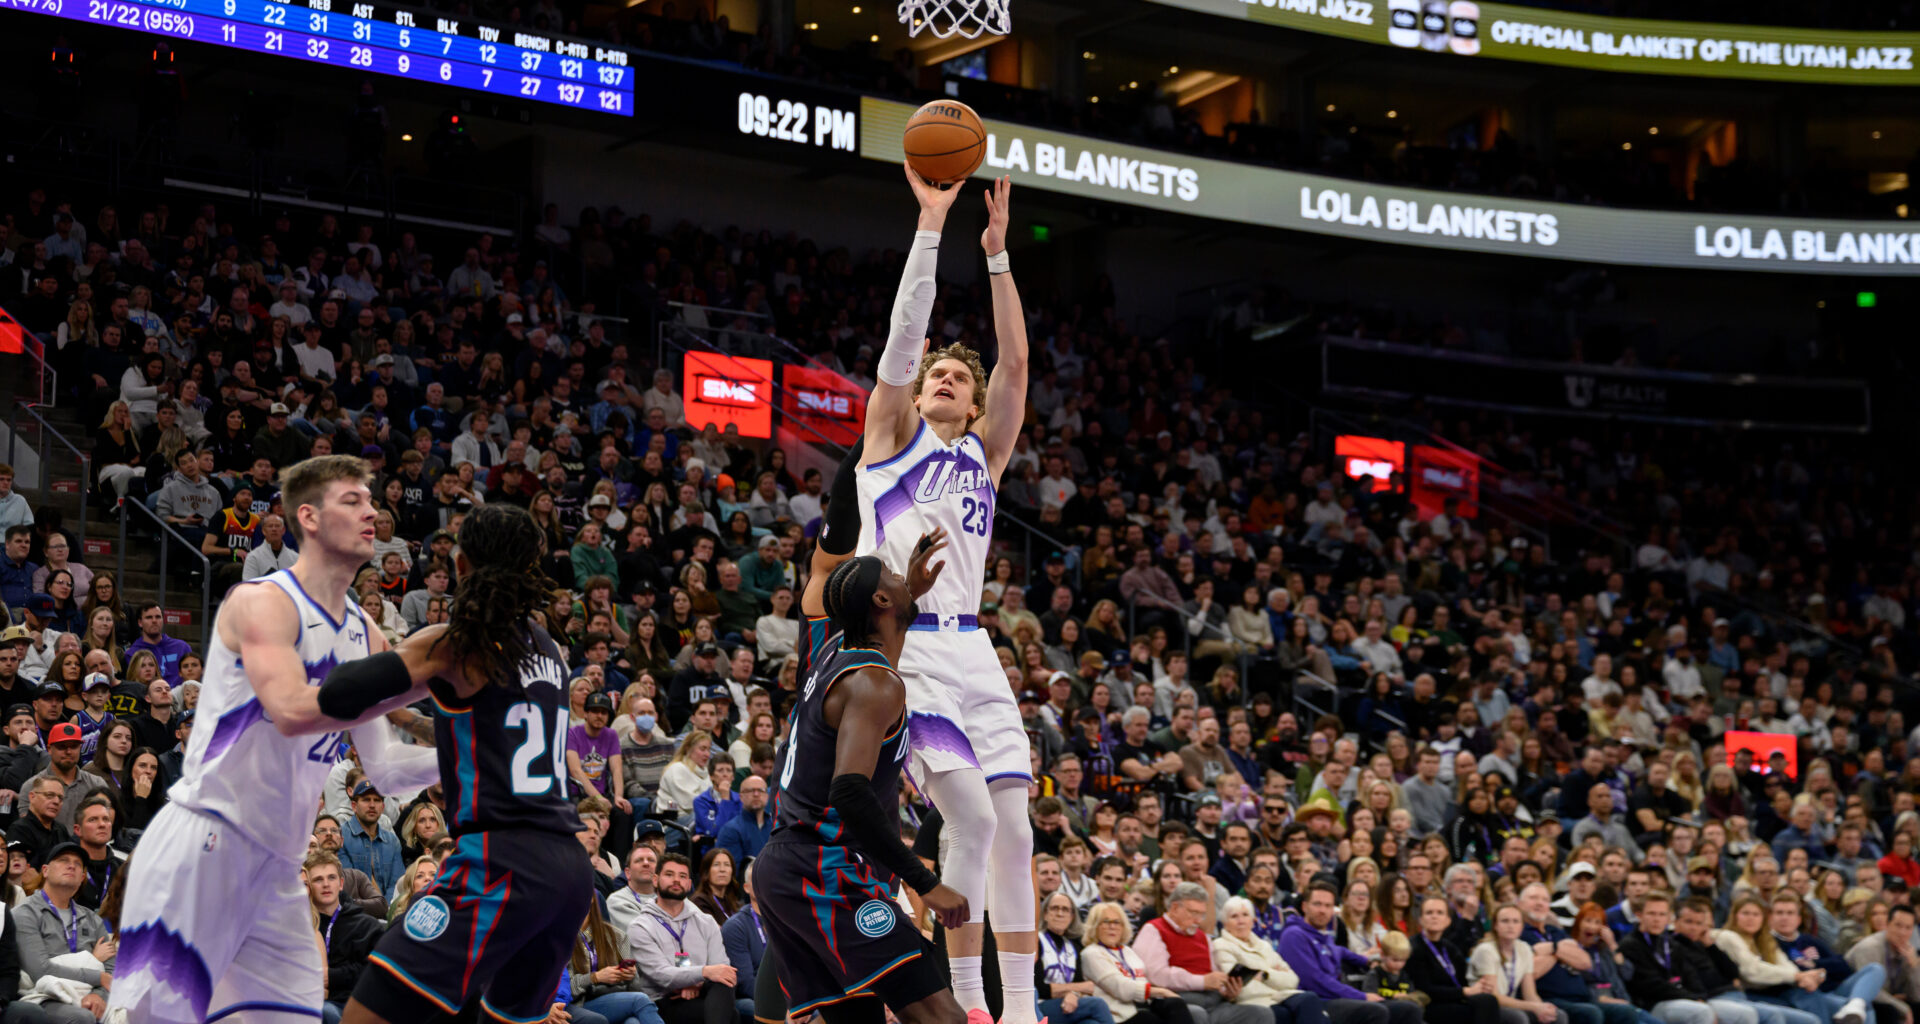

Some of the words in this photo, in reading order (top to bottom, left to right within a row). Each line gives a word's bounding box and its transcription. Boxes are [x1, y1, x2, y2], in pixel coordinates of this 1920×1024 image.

[353, 4, 374, 19] AST
[396, 11, 415, 27] STL
[437, 19, 458, 35] BLK
[479, 26, 499, 42] TOV
[515, 33, 549, 52] BENCH
[556, 41, 588, 59] O-RTG
[596, 48, 628, 66] D-RTG
[1319, 2, 1374, 25] JAZZ
[89, 0, 140, 26] 21/22
[144, 8, 194, 37] (95%)
[222, 24, 236, 43] 11
[264, 31, 283, 51] 21
[307, 39, 329, 59] 32
[350, 46, 372, 67] 28
[398, 55, 410, 73] 9
[440, 63, 451, 81] 6
[482, 70, 493, 87] 7
[521, 77, 541, 96] 27
[558, 84, 584, 104] 137
[599, 91, 622, 111] 121
[224, 0, 236, 16] 9
[264, 5, 286, 25] 22
[310, 13, 328, 33] 31
[353, 21, 371, 41] 31
[400, 30, 410, 48] 5
[442, 37, 452, 54] 7
[480, 45, 496, 64] 12
[521, 52, 541, 71] 37
[560, 59, 583, 79] 121
[598, 66, 624, 86] 137
[1491, 21, 1589, 53] OFFICIAL
[1592, 32, 1697, 60] BLANKET
[1700, 39, 1733, 63] OF
[1735, 41, 1783, 65] THE
[1784, 44, 1847, 68] UTAH
[1849, 47, 1913, 70] JAZZ
[738, 92, 807, 143] 09:22
[815, 107, 855, 152] PM
[986, 133, 1030, 173] LA
[1035, 142, 1199, 202] BLANKETS
[1300, 186, 1381, 228] LOLA
[1387, 199, 1558, 246] BLANKETS
[1696, 225, 1787, 260] LOLA
[913, 460, 987, 504] UTAH
[962, 496, 989, 538] 23
[103, 694, 140, 714] AZZ
[504, 701, 570, 800] 24
[863, 909, 886, 921] DETROIT
[865, 915, 888, 928] PISTONS
